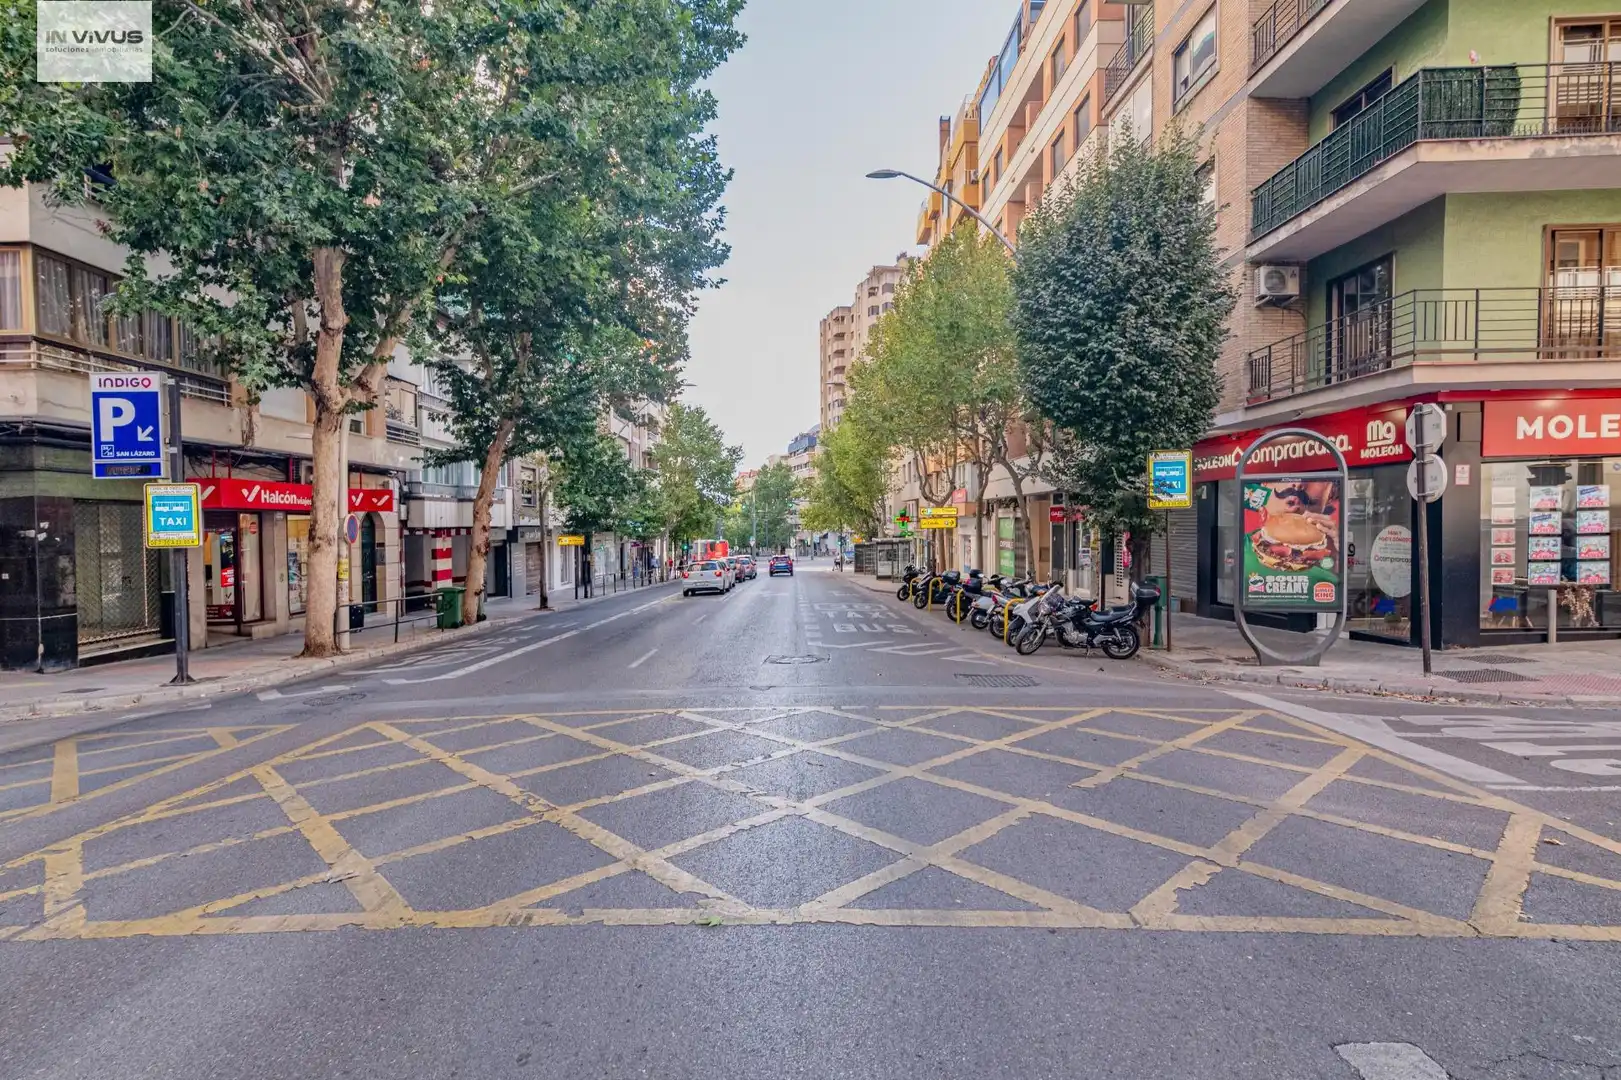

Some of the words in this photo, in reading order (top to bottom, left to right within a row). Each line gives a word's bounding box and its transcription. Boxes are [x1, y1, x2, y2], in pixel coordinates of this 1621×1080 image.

[98, 377, 152, 389] INDIGO
[99, 397, 136, 442] P
[1516, 414, 1621, 440] MOLE
[1360, 444, 1404, 458] MOLEON
[261, 489, 297, 504] Halcón
[159, 517, 187, 526] TAXI
[1265, 582, 1309, 594] CREAMY
[832, 623, 920, 635] BUS
